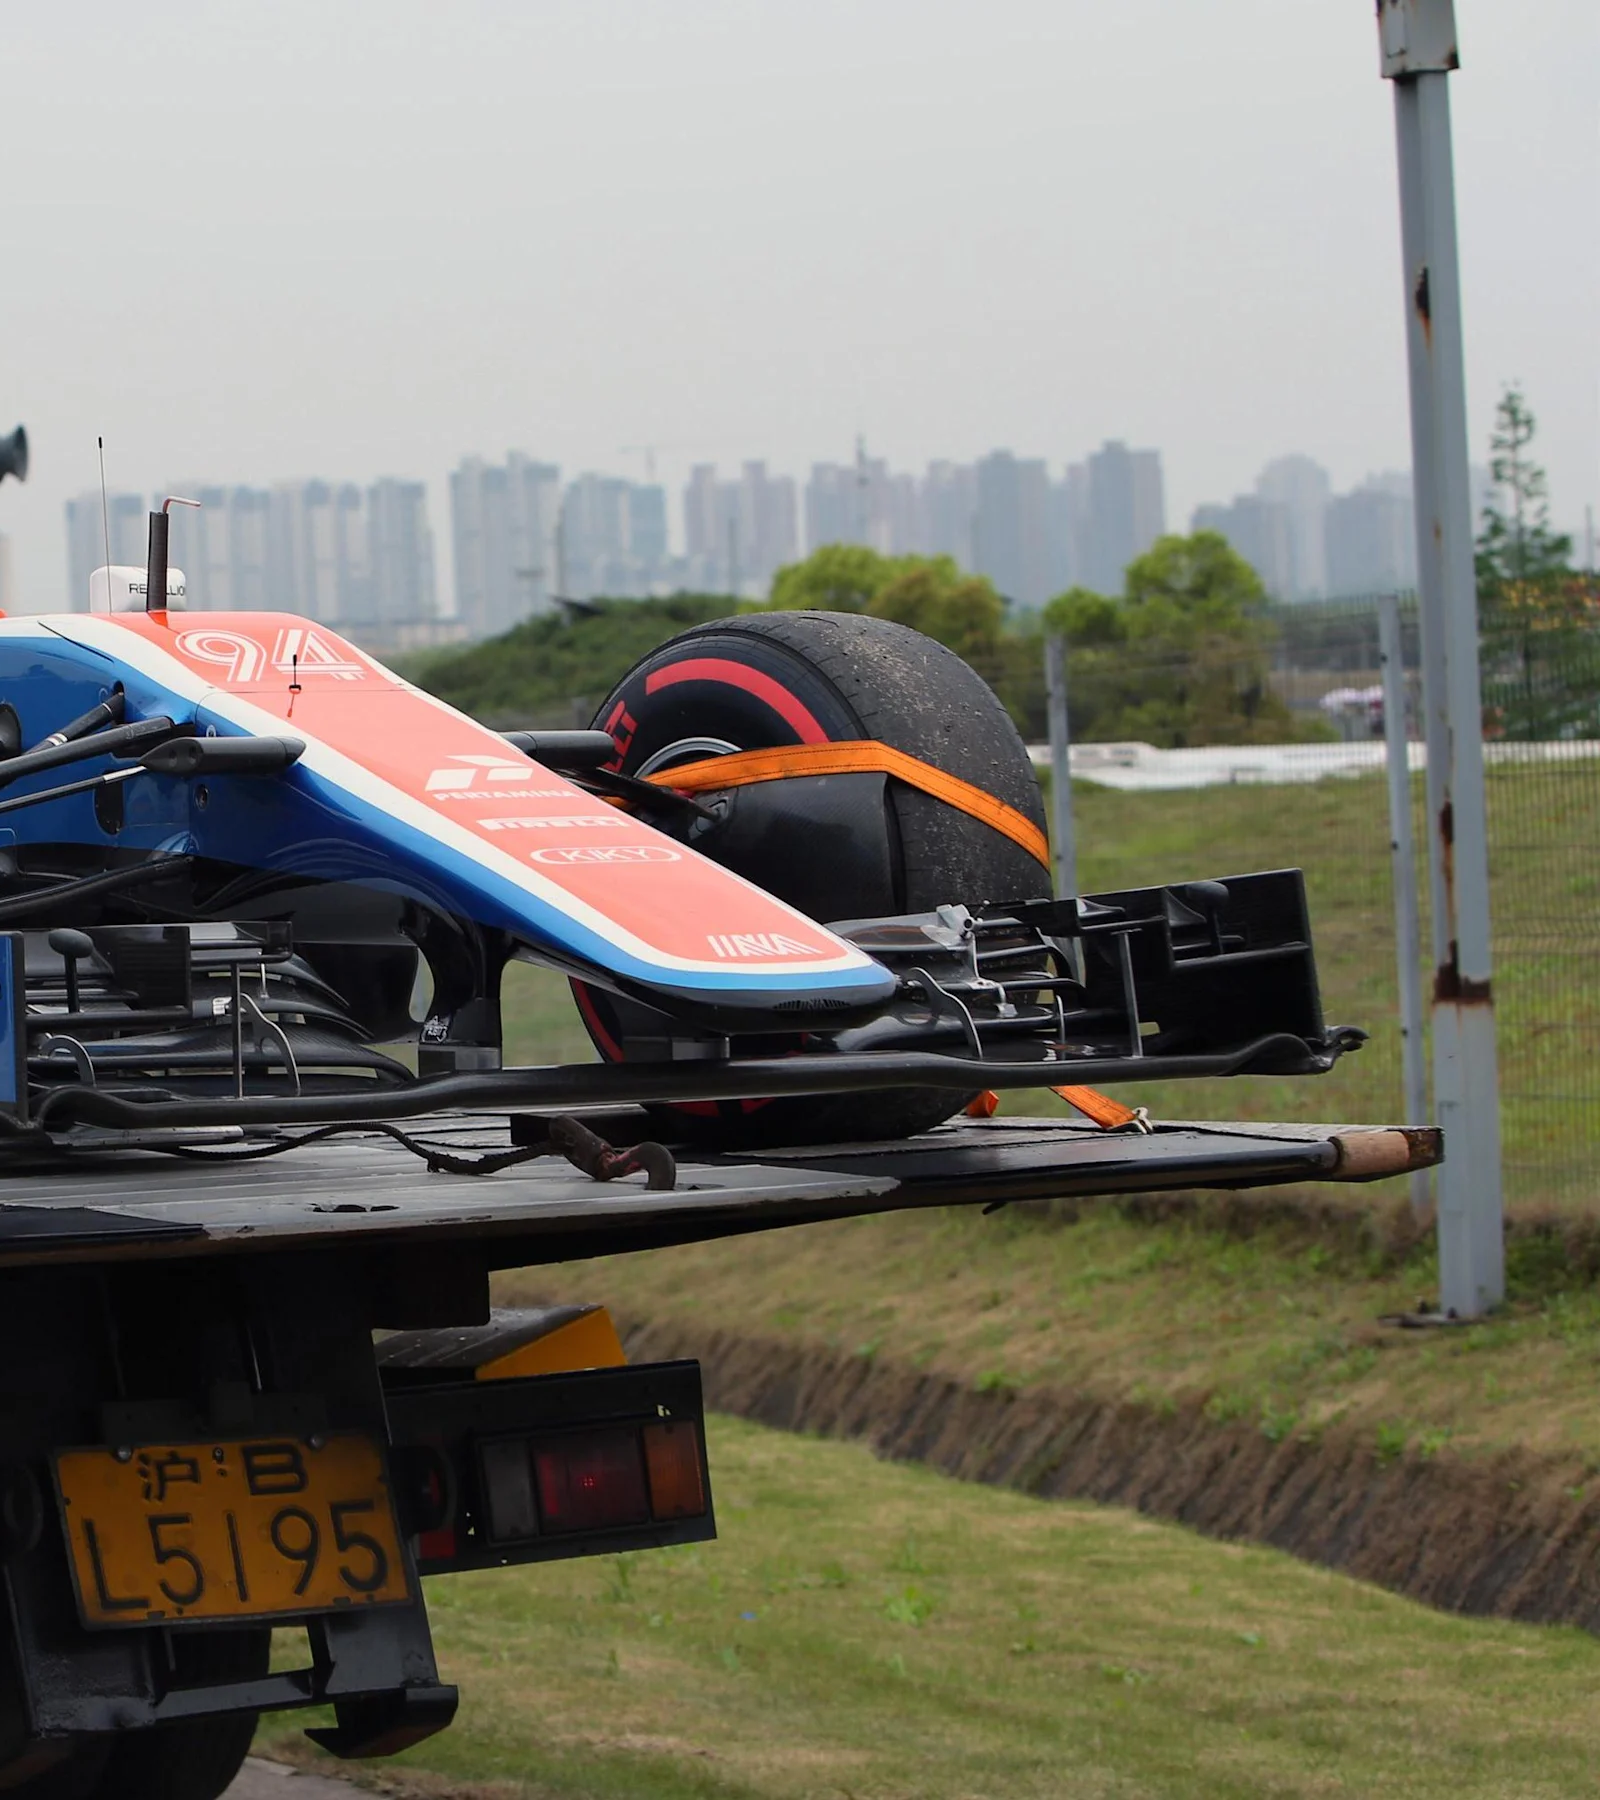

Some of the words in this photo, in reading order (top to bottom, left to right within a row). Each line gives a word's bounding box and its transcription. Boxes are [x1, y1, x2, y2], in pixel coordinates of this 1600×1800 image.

[175, 628, 368, 683] 94
[433, 789, 582, 801] PERTAMINA
[476, 815, 632, 831] PIRELLI
[557, 848, 651, 862] KIKY
[83, 1501, 389, 1611] L5195
